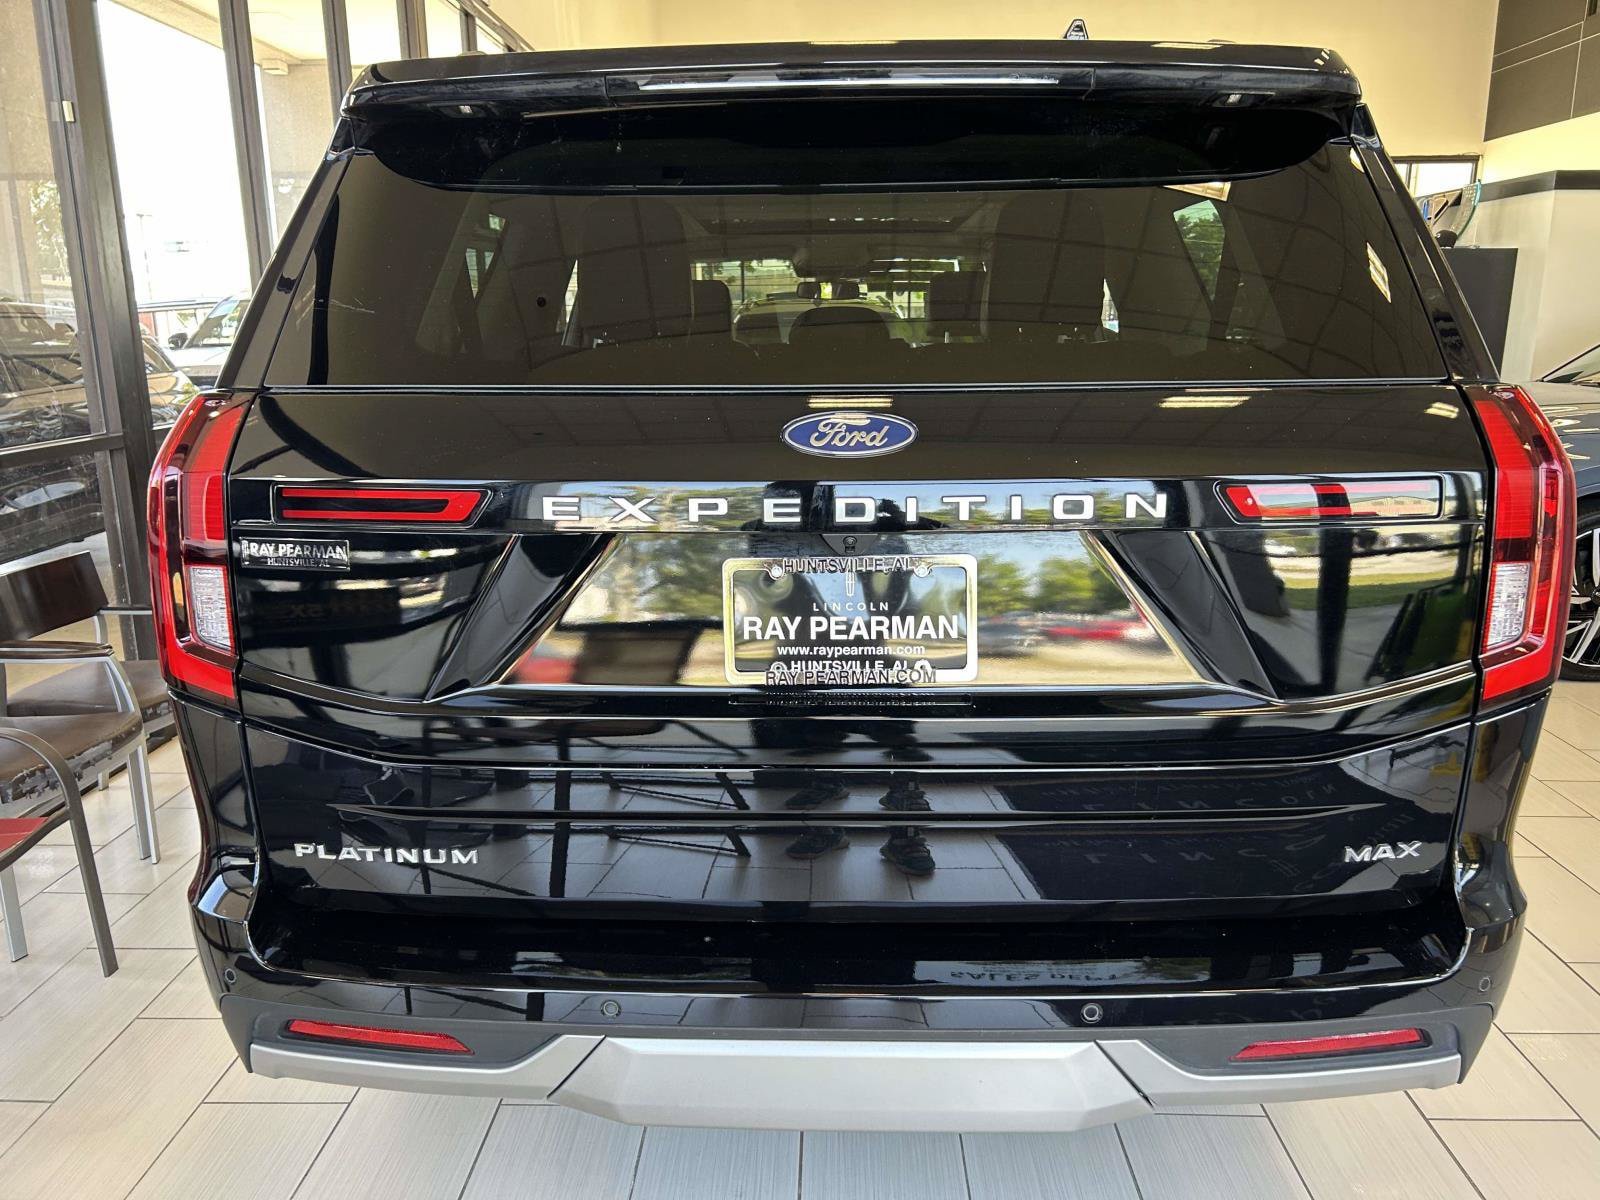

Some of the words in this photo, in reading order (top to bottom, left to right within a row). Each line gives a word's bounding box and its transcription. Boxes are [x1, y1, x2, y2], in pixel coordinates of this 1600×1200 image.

[810, 418, 890, 447] Ford
[542, 492, 1168, 524] EXPEDITION
[250, 542, 275, 557] RAY
[278, 543, 347, 562] PEARMAN
[892, 557, 912, 572] AL
[812, 602, 889, 612] LINCOLN
[743, 615, 802, 640] RAY
[809, 615, 959, 640] PEARMAN
[776, 644, 926, 658] www.raypearman.com
[765, 670, 800, 685] RAY
[804, 669, 937, 685] PEARMAN.COM
[293, 842, 479, 865] PLATINUM
[1343, 840, 1422, 863] MAX
